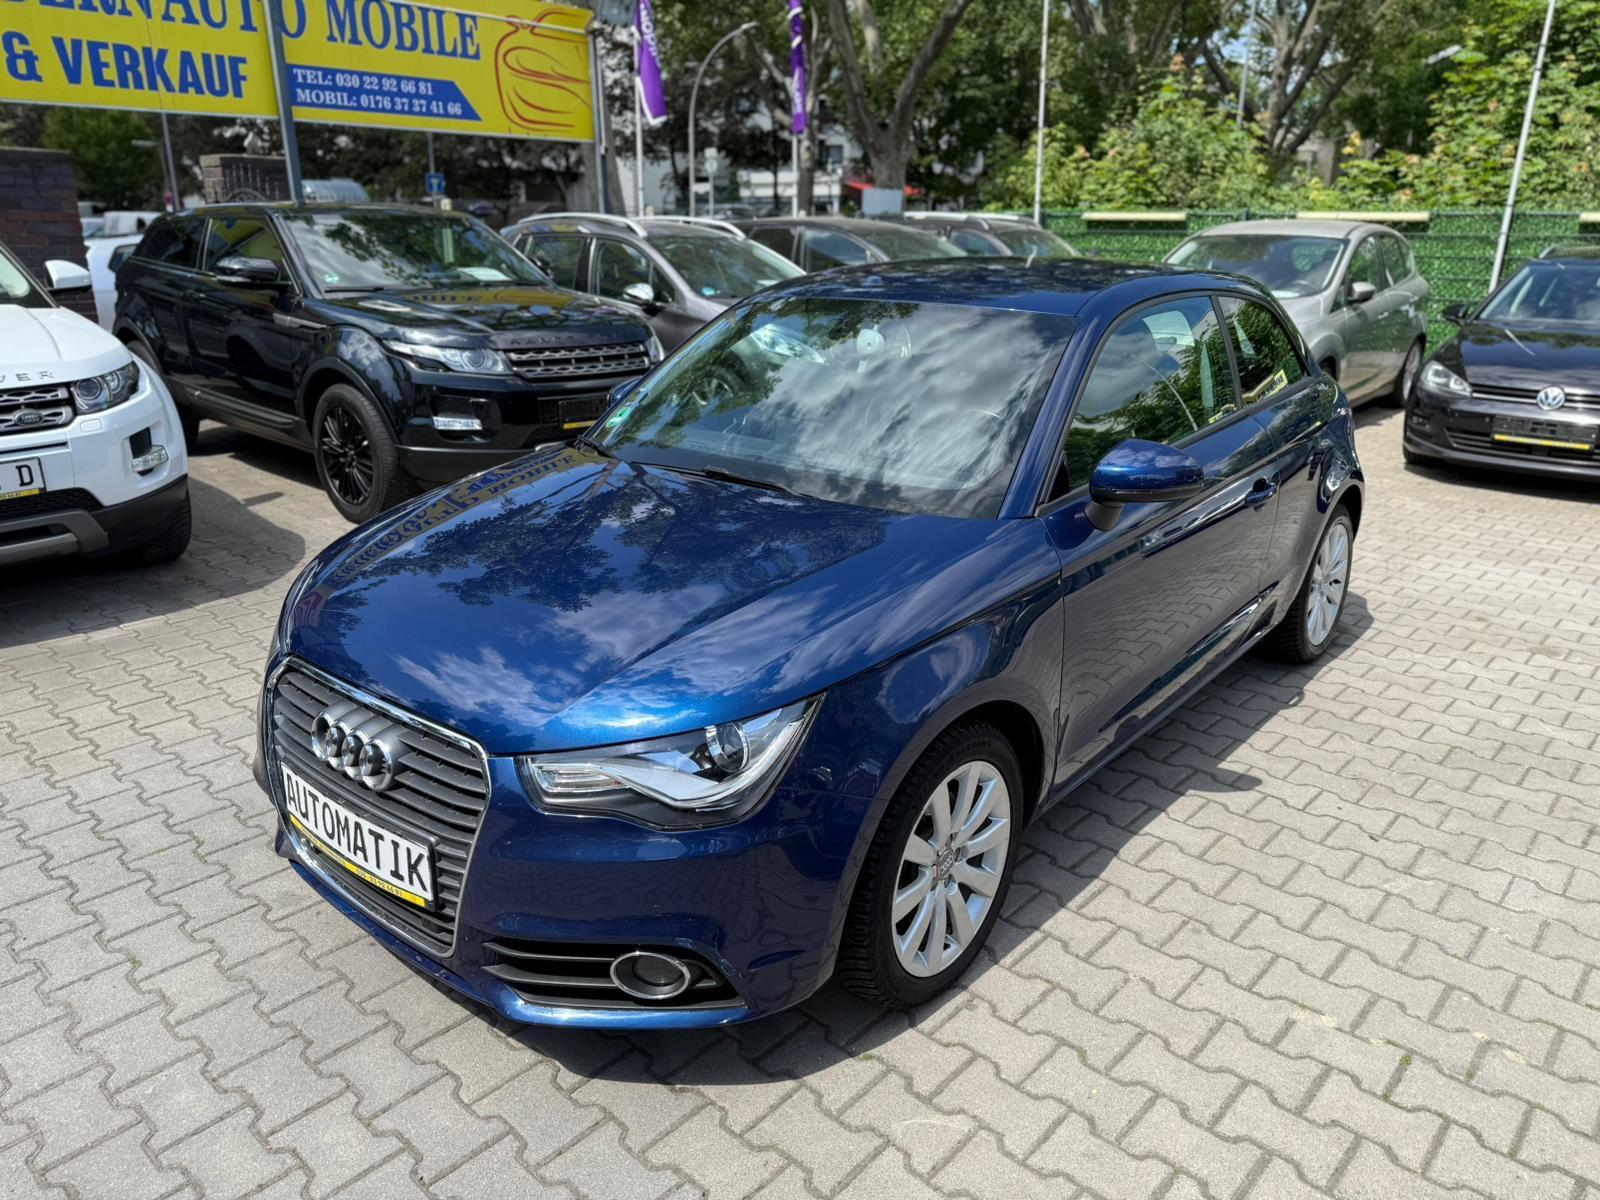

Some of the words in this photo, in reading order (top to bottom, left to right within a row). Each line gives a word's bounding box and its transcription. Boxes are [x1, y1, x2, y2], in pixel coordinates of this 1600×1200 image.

[326, 0, 481, 60] MOBILE
[1, 31, 43, 82] &
[51, 36, 248, 98] VERKAUF
[293, 68, 332, 86] TEL:
[335, 73, 360, 88] 030
[363, 75, 379, 90] 22
[381, 77, 398, 92] 92
[400, 79, 416, 94] 66
[418, 81, 433, 96] 81
[296, 88, 358, 107] MOBIL:
[360, 94, 391, 110] 0176
[394, 97, 409, 111] 37
[412, 98, 427, 112] 37
[430, 100, 444, 114] 41
[447, 101, 462, 116] 66
[15, 464, 35, 487] D
[286, 772, 429, 893] AUTOMATIK
